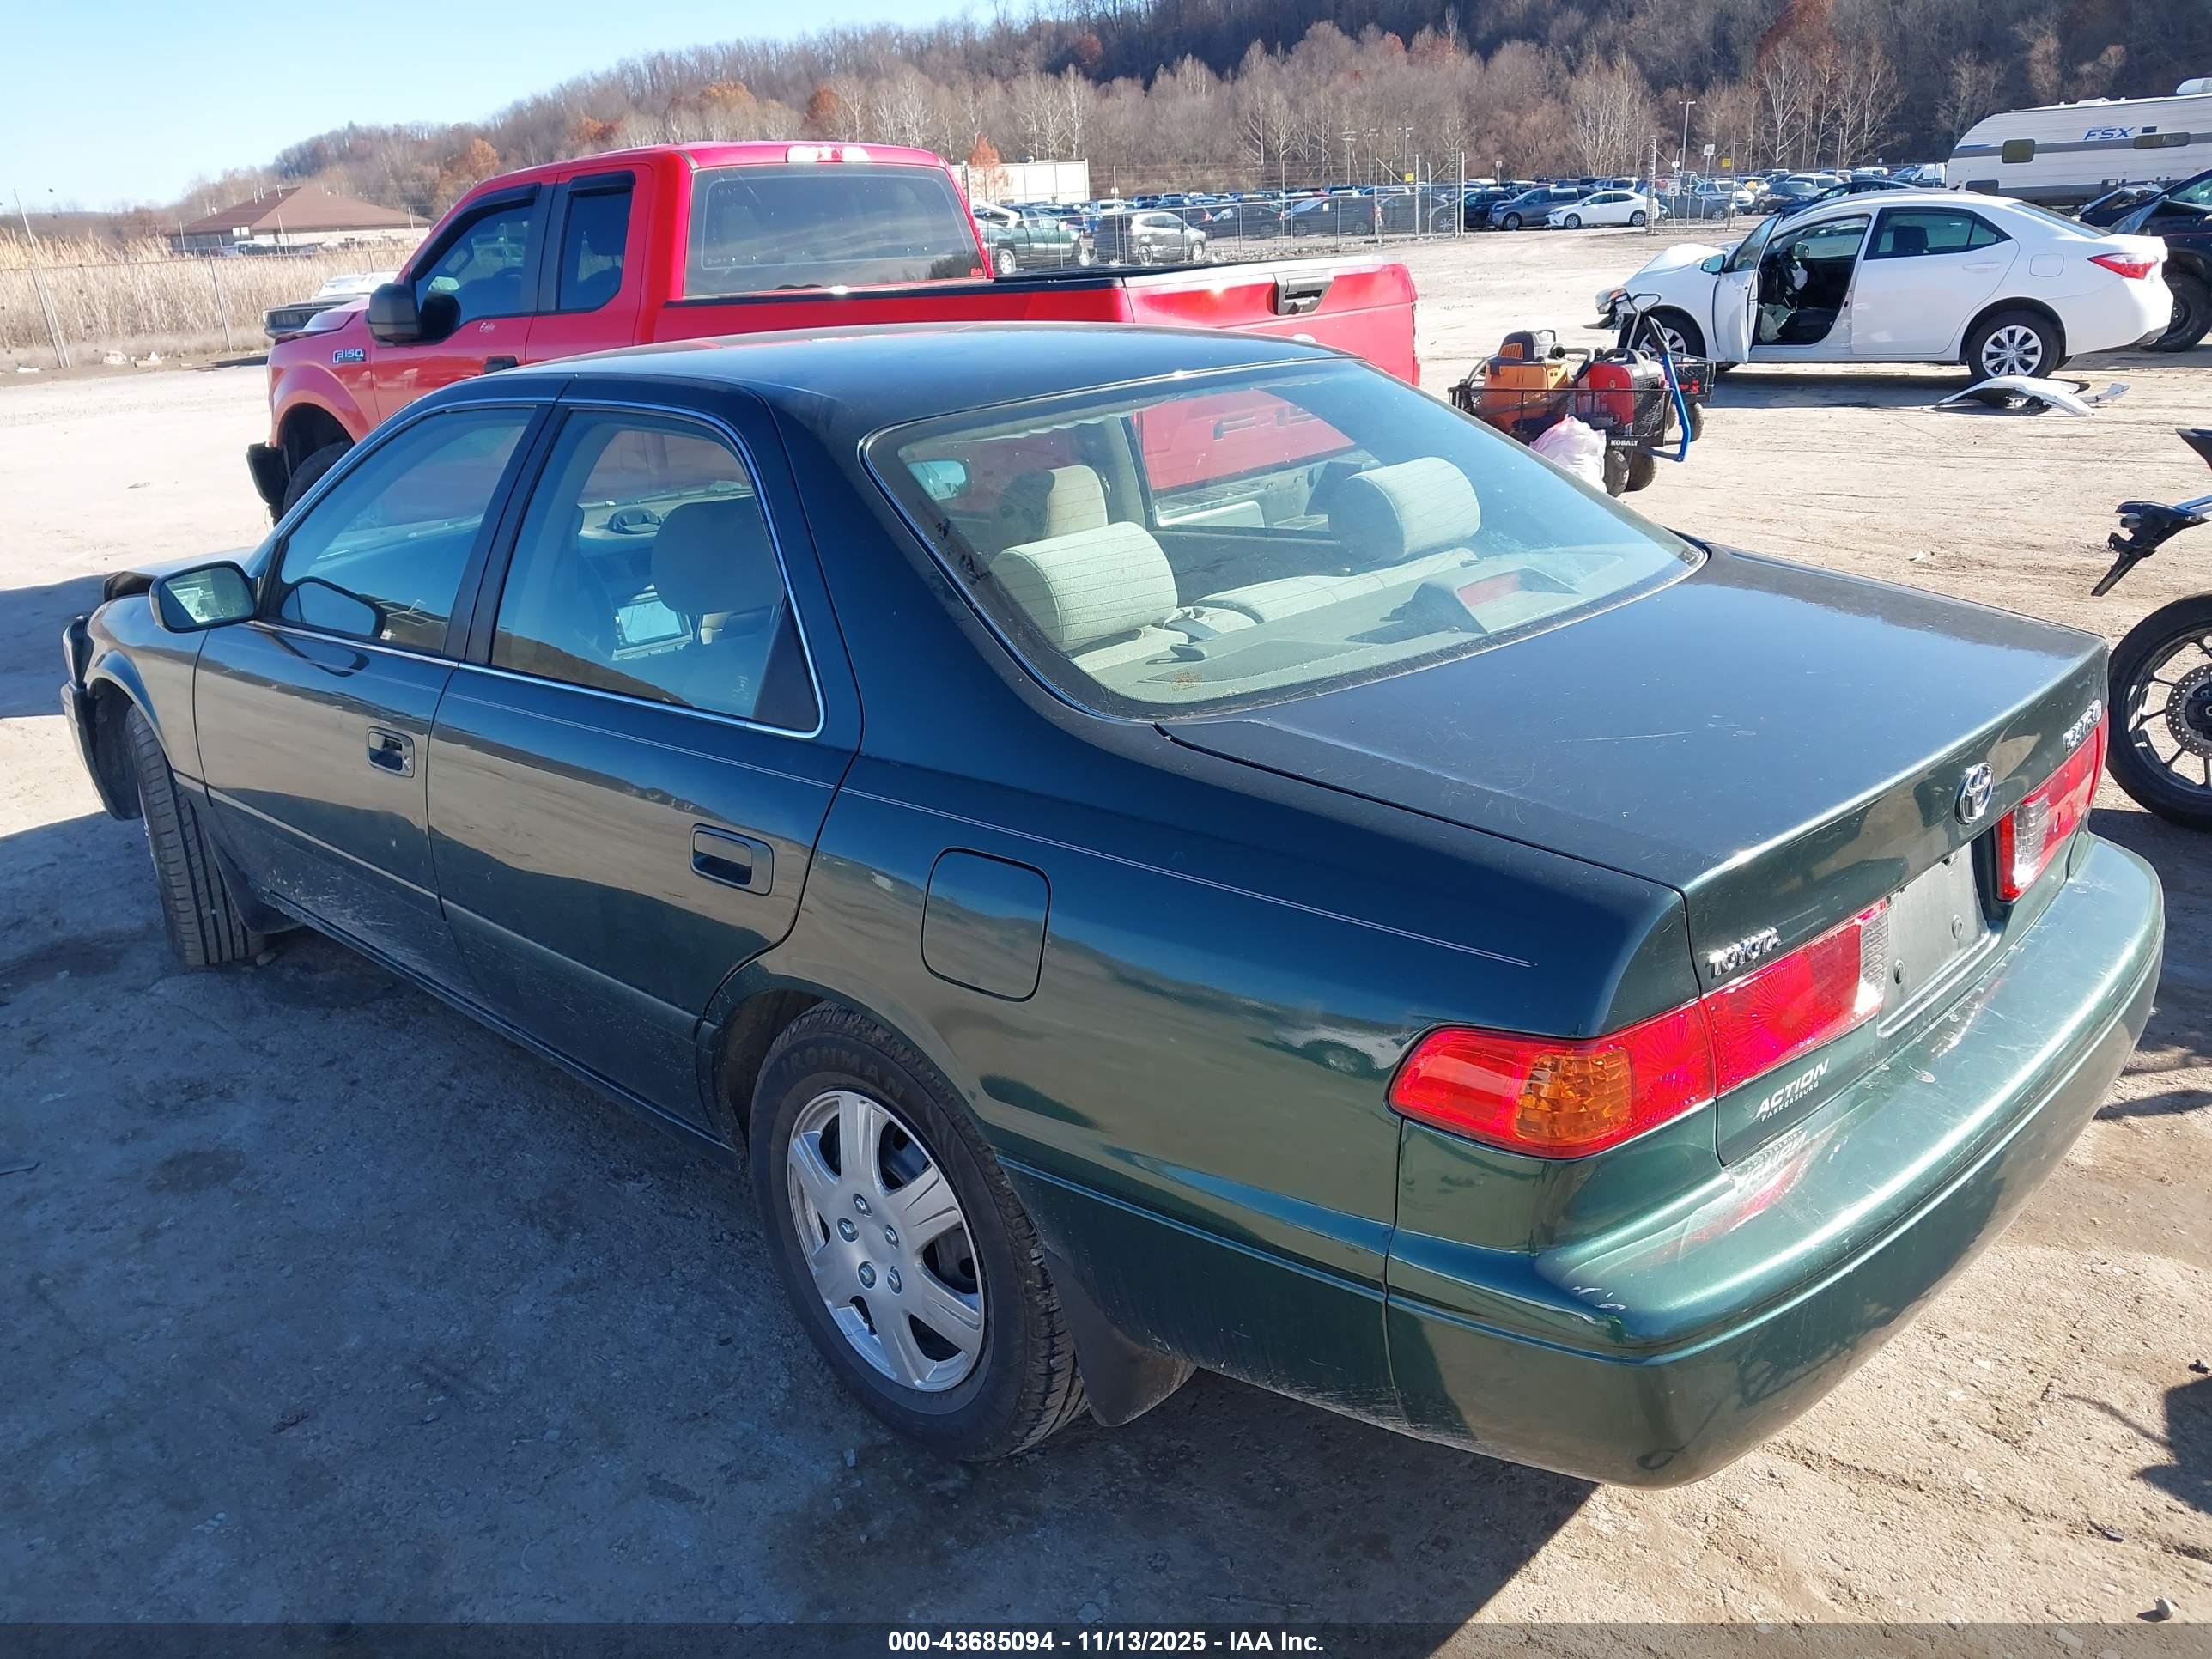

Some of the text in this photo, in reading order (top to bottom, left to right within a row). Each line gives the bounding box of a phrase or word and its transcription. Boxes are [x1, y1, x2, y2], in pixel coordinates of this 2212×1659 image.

[2083, 127, 2136, 140] FSX
[1707, 927, 1782, 976] TOYOTA
[781, 1045, 907, 1100] IRONMAN
[1752, 1057, 1830, 1121] ACTION
